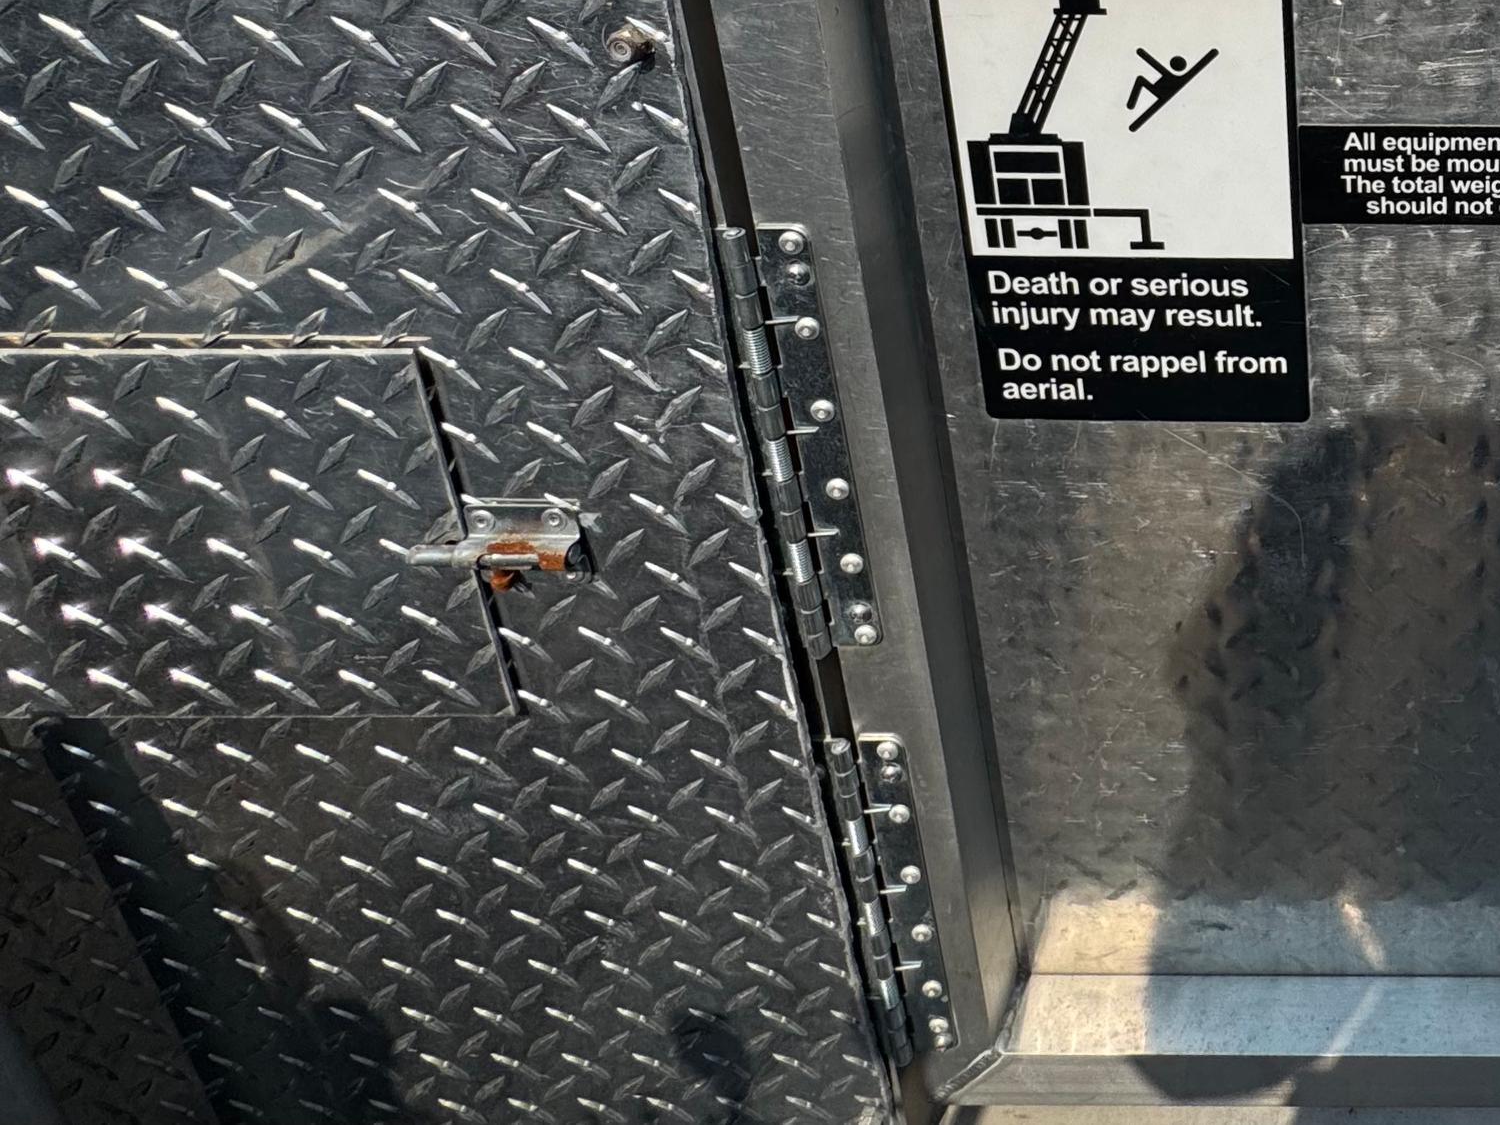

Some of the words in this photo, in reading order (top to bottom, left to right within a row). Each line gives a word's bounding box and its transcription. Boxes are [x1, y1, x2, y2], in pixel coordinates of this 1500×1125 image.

[1343, 133, 1375, 152] All
[1344, 156, 1404, 172] must
[1411, 155, 1440, 172] be
[1341, 175, 1385, 193] The
[1392, 177, 1444, 194] total
[1366, 197, 1448, 215] should
[1455, 199, 1493, 215] not
[988, 270, 1080, 296] Death
[1089, 276, 1123, 296] or
[1131, 273, 1249, 297] serious
[991, 301, 1079, 330] injury
[1090, 306, 1155, 332] may
[1165, 304, 1262, 327] result.
[998, 348, 1042, 371] Do
[1051, 351, 1101, 372] not
[1110, 351, 1206, 378] rappel
[1215, 351, 1287, 374] from
[1002, 378, 1093, 400] aerial.
